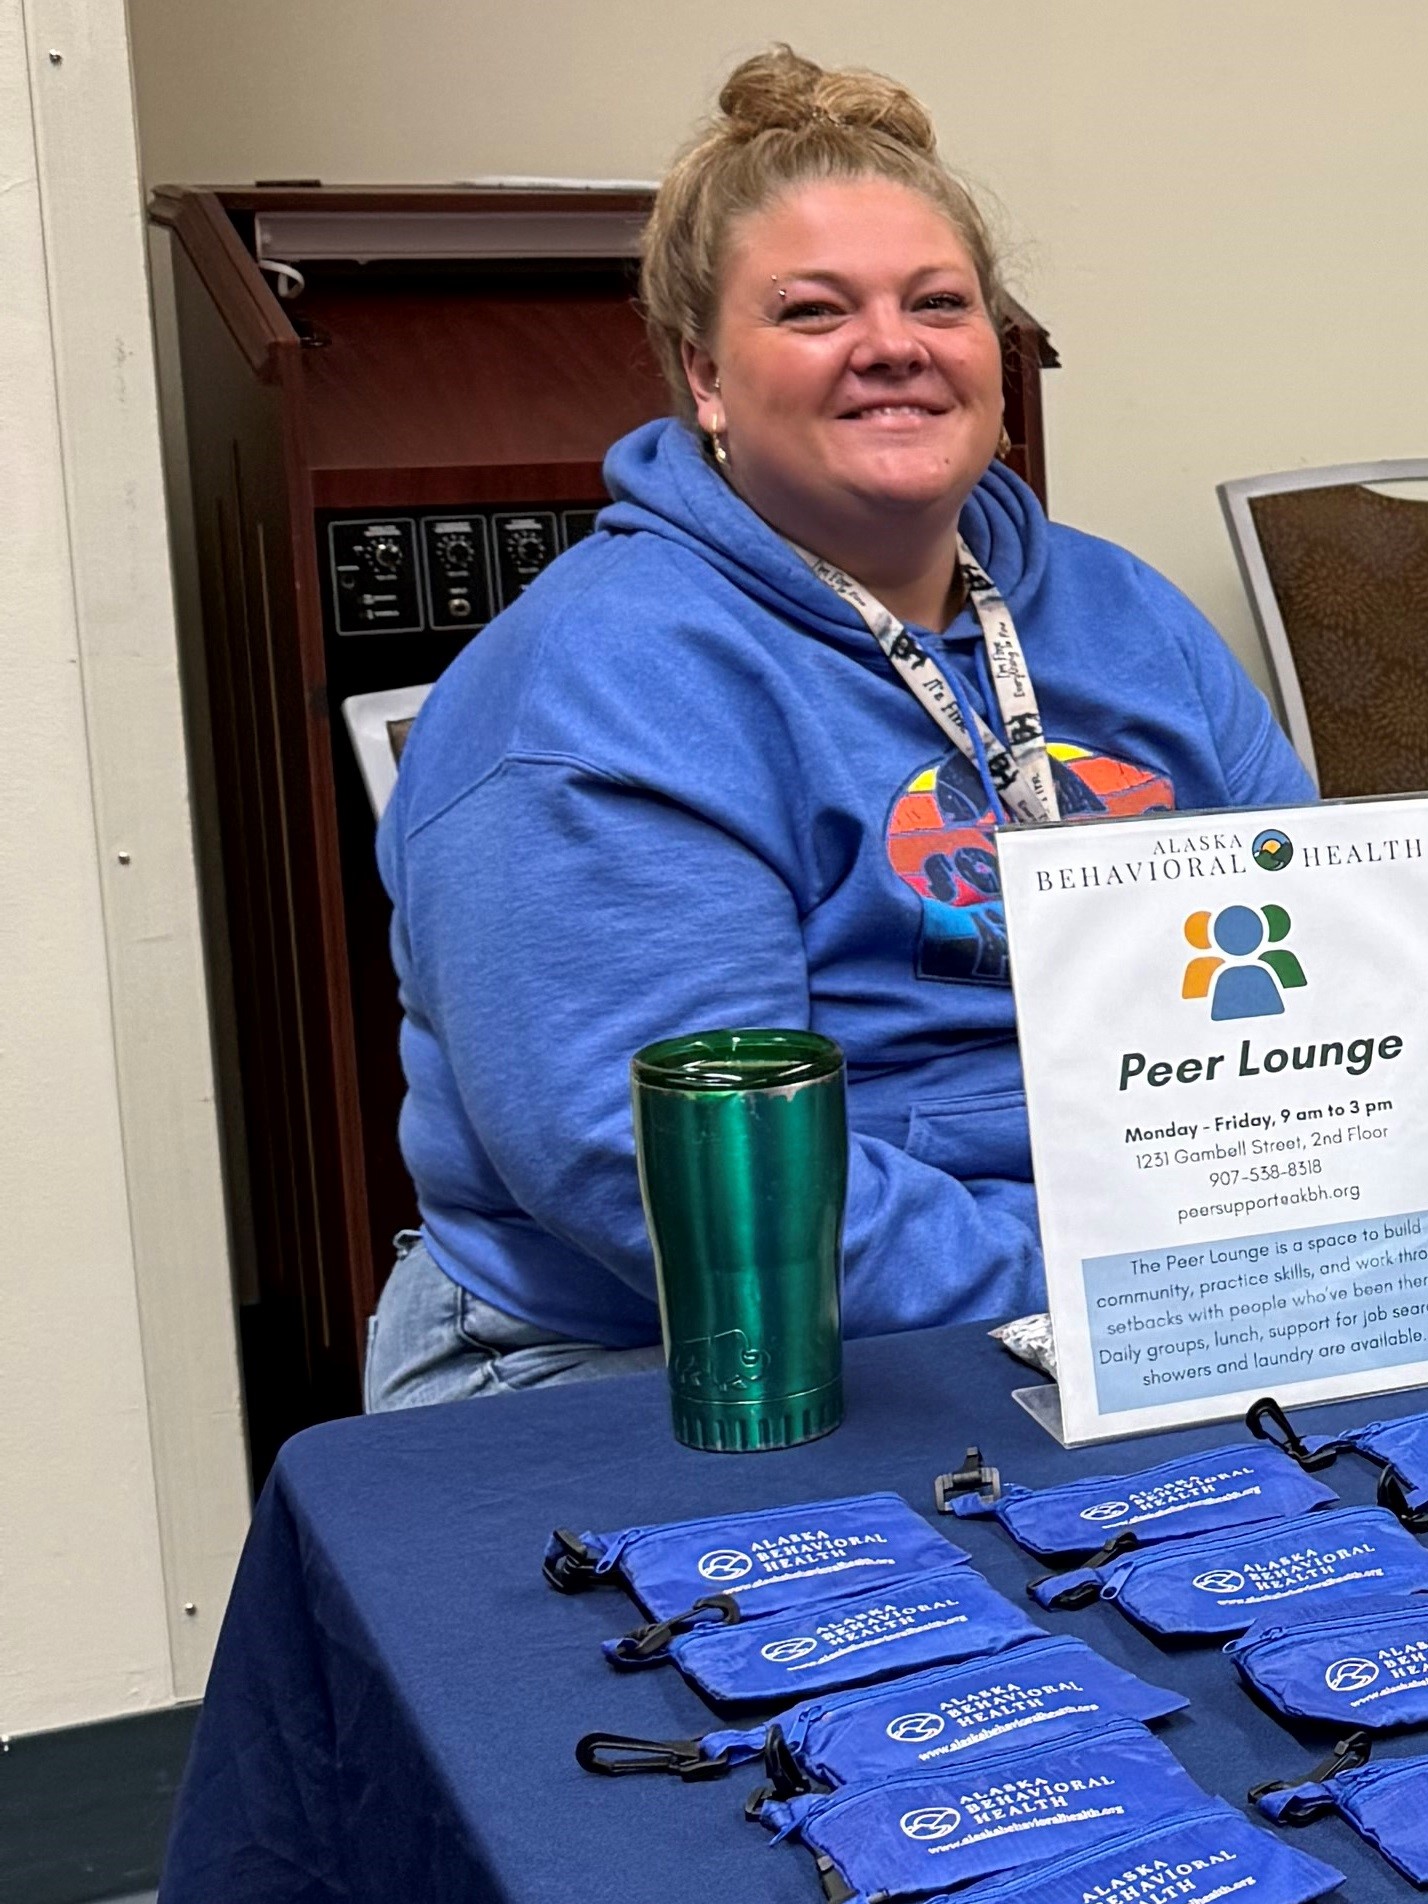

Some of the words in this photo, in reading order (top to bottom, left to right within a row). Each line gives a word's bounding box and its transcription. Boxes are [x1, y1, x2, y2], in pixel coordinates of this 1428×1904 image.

[1037, 854, 1246, 892] BEHAVIORAL
[1304, 838, 1422, 868] HEALTH
[1153, 834, 1243, 855] ALASKA
[1119, 1052, 1224, 1090] Peer
[1239, 1032, 1403, 1076] Lounge
[1125, 1122, 1198, 1143] Monday
[1215, 1114, 1276, 1132] Friday,
[1280, 1110, 1291, 1123] 9
[1296, 1109, 1322, 1120] am
[1328, 1104, 1344, 1117] to
[1350, 1100, 1360, 1114] 3
[1366, 1099, 1392, 1116] pm
[1136, 1152, 1169, 1169] 1231
[1174, 1140, 1246, 1164] Gambell
[1252, 1137, 1306, 1154] Street,
[1311, 1128, 1342, 1147] 2nd
[1348, 1125, 1388, 1141] Floor
[1209, 1159, 1322, 1188] 907-538-8318
[1131, 1258, 1160, 1276] The
[1167, 1253, 1204, 1270] Peer
[1209, 1243, 1269, 1268] Lounge
[1276, 1242, 1288, 1255] is
[1293, 1240, 1302, 1252] a
[1308, 1232, 1357, 1255] space
[1363, 1227, 1379, 1241] to
[1384, 1219, 1421, 1240] build
[1097, 1283, 1194, 1309] community,
[1200, 1273, 1268, 1297] practice
[1274, 1261, 1315, 1284] skills,
[1320, 1257, 1350, 1275] and
[1356, 1250, 1394, 1269] work
[1107, 1312, 1183, 1336] setbacks
[1188, 1302, 1223, 1323] with
[1230, 1295, 1287, 1321] people
[1292, 1286, 1347, 1307] who've
[1353, 1279, 1393, 1298] been
[1099, 1345, 1141, 1366] Daily
[1147, 1338, 1209, 1363] groups,
[1215, 1329, 1264, 1348] lunch,
[1269, 1316, 1330, 1341] support
[1335, 1312, 1358, 1327] for
[1362, 1307, 1387, 1329] job
[1143, 1364, 1212, 1386] showers
[1217, 1356, 1249, 1374] and
[1254, 1347, 1313, 1369] laundry
[1319, 1343, 1346, 1358] are
[1351, 1331, 1427, 1354] available.
[757, 1533, 887, 1563] BEHAVIORAL
[763, 1549, 846, 1572] HEALTH
[947, 1681, 1084, 1719] BEHAVIORAL
[957, 1698, 1044, 1728] HEALTH
[960, 1777, 1049, 1804] ALASKA
[965, 1775, 1115, 1815] BEHAVIORAL
[973, 1796, 1068, 1825] HEALTH
[1082, 1859, 1169, 1904] ALASKA
